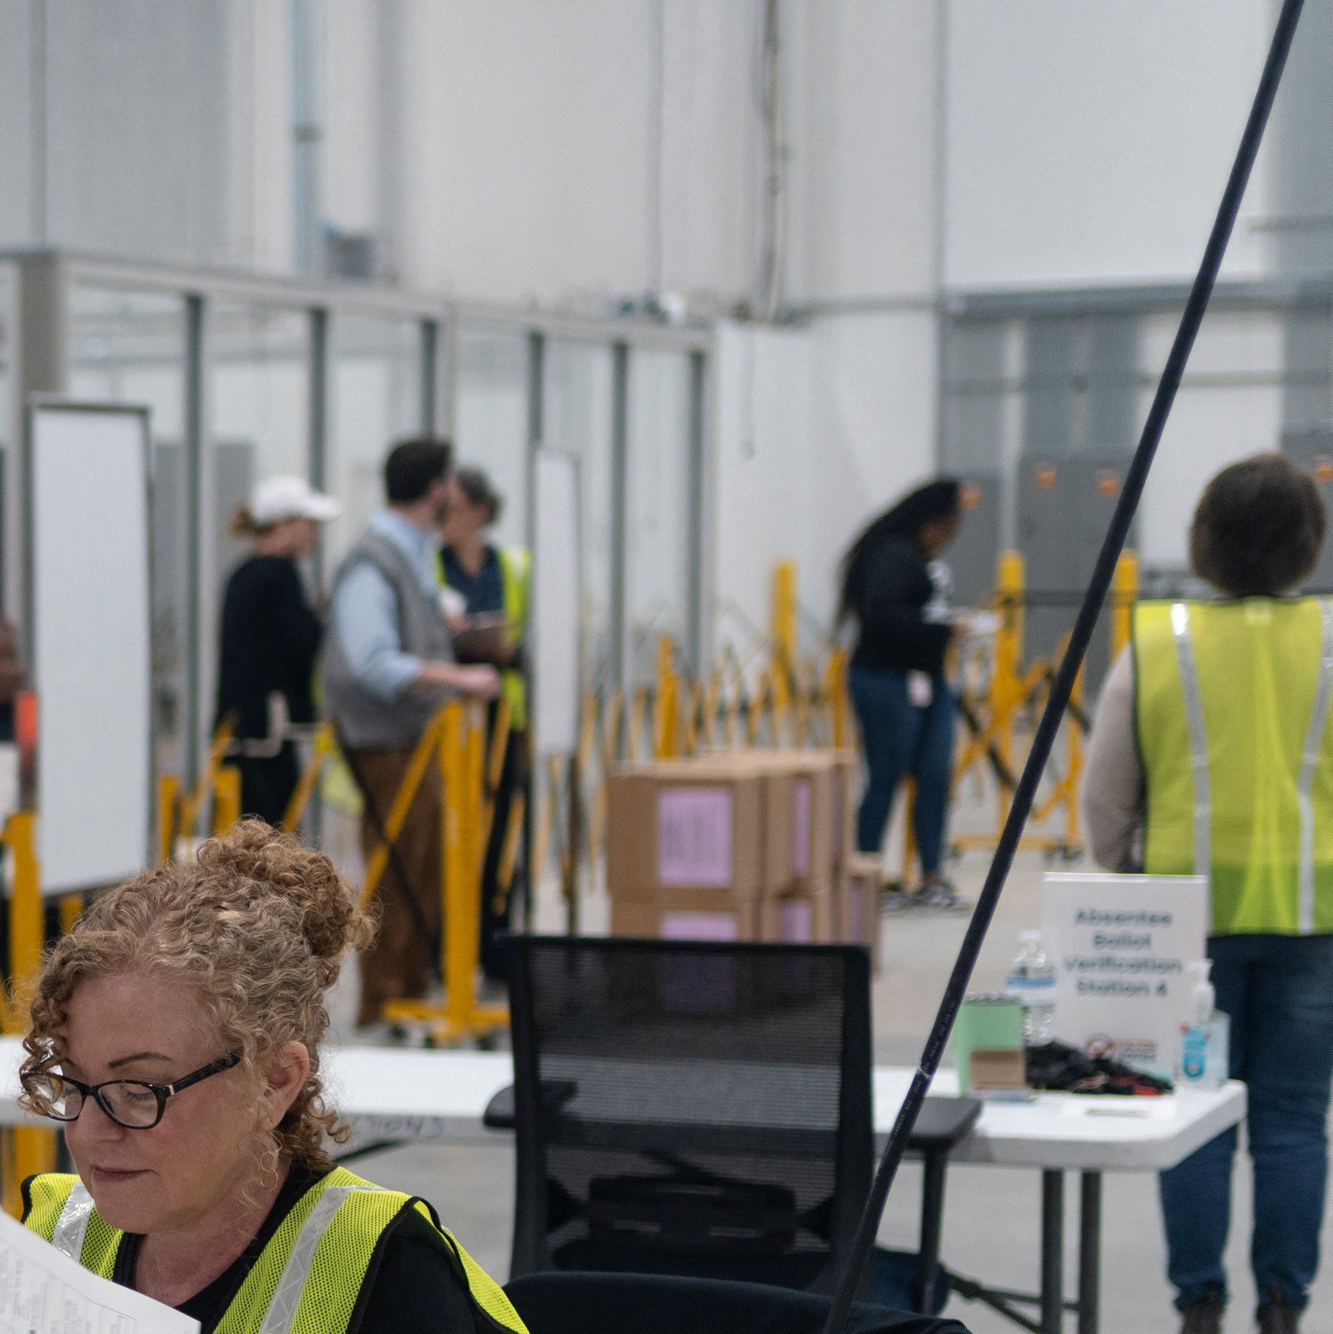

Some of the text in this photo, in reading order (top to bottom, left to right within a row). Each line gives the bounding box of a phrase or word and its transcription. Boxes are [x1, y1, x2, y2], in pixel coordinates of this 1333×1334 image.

[1075, 908, 1172, 926] Absentee
[1093, 931, 1151, 950] Ballot
[1064, 954, 1183, 975] Verification
[1076, 978, 1150, 997] Station
